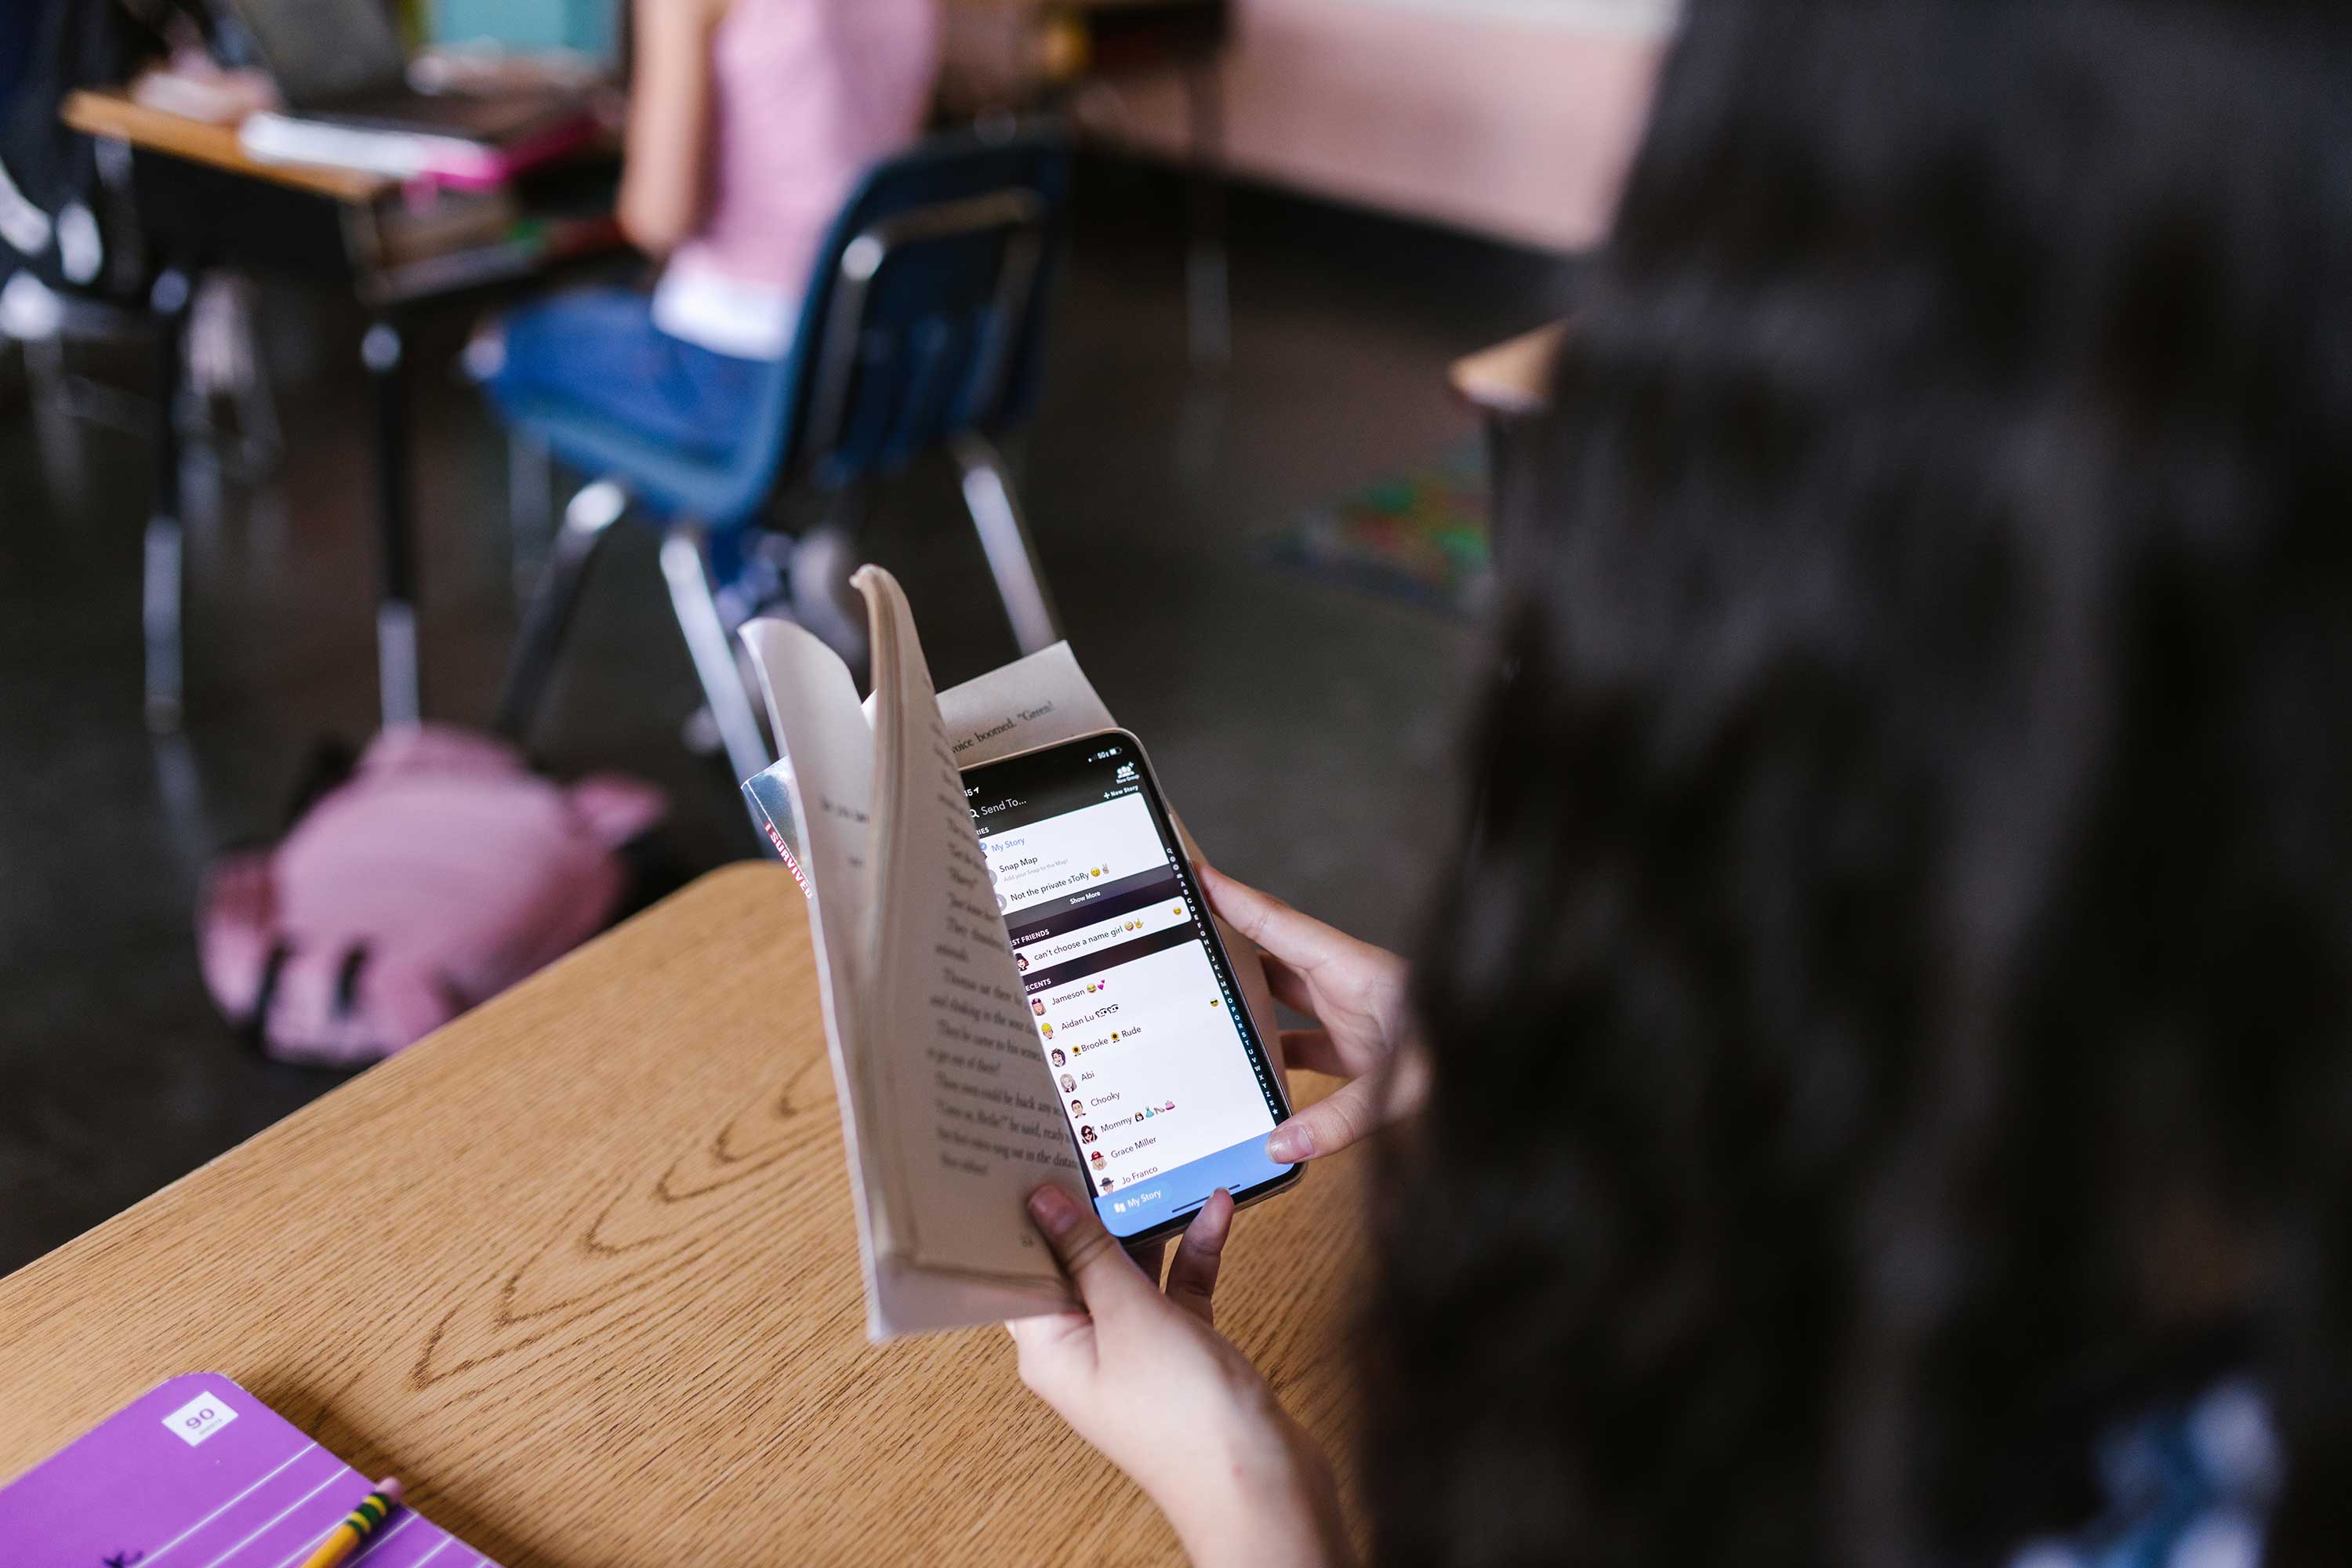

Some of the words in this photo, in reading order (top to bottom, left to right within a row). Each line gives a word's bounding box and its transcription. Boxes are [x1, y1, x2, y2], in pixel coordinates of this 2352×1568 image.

[1123, 785, 1139, 793] Story
[981, 800, 1006, 815] Send
[1005, 798, 1027, 808] To...
[991, 843, 1004, 852] My
[1004, 837, 1025, 849] Story
[764, 822, 772, 832] I
[770, 831, 813, 899] SURVIVED
[999, 862, 1019, 873] Snap
[1019, 856, 1038, 867] Map
[1027, 867, 1040, 876] Snap
[1010, 892, 1025, 902] Not
[1026, 887, 1040, 897] the
[1040, 879, 1067, 894] private
[1067, 872, 1090, 884] sToRy
[1069, 894, 1086, 905] Show
[1085, 890, 1102, 901] More
[1021, 928, 1050, 944] FRIENDS
[1033, 948, 1054, 961] can't
[1053, 939, 1081, 956] choose
[1082, 938, 1087, 946] a
[1088, 931, 1110, 945] name
[1110, 925, 1124, 940] girl
[1051, 988, 1086, 1006] Jameson
[1061, 1018, 1084, 1031] Aidan
[1084, 1014, 1095, 1023] Lu
[1080, 1036, 1109, 1053] Brooke
[1121, 1025, 1142, 1039] Rude
[1080, 1070, 1095, 1082] Abi
[1091, 1091, 1120, 1108] Chooky
[1100, 1115, 1133, 1133] Mommy
[1110, 1145, 1134, 1159] Grace
[1134, 1135, 1157, 1151] Miller
[1122, 1176, 1131, 1185] Jo
[1131, 1166, 1159, 1181] Franco
[1127, 1196, 1142, 1208] My
[1142, 1189, 1162, 1203] Story
[186, 1408, 215, 1429] 90
